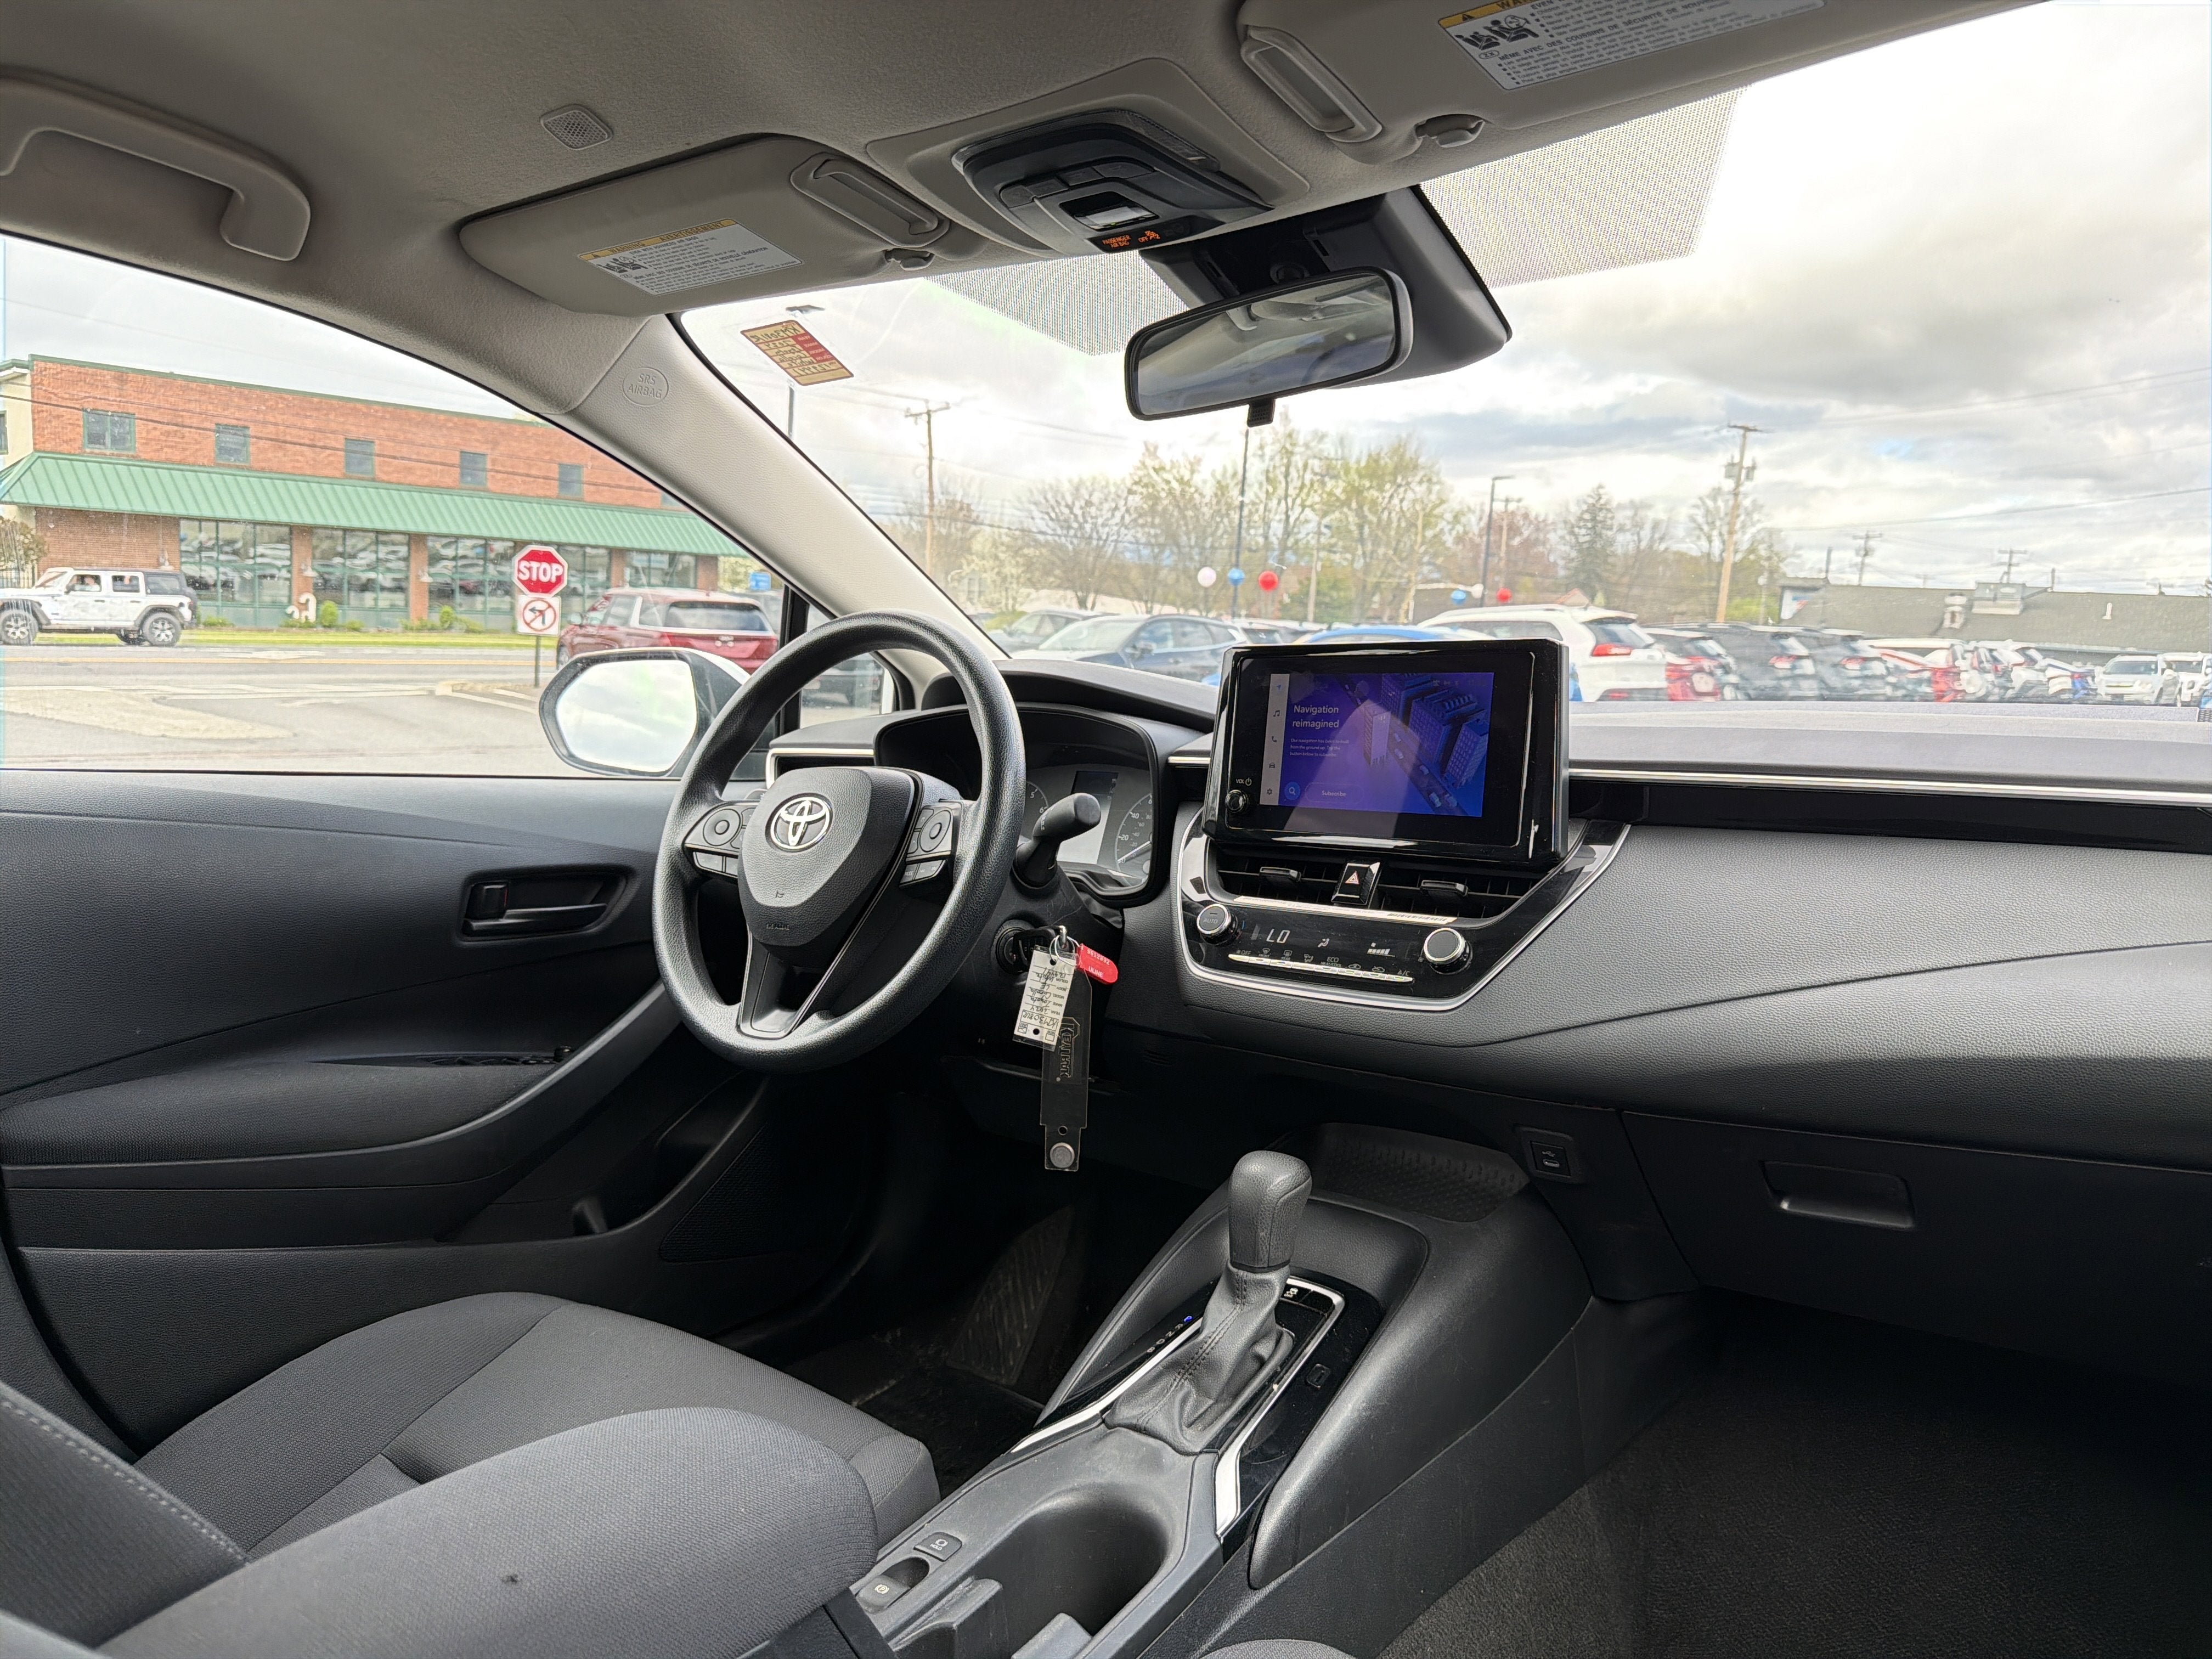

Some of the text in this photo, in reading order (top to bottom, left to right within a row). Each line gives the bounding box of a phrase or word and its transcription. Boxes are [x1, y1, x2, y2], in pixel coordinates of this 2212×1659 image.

[1521, 44, 1545, 54] AVEC
[1545, 39, 1564, 47] DES
[1563, 27, 1606, 42] COUSSINS
[610, 242, 645, 253] WARNING
[659, 222, 726, 241] AVERTISSEMENT
[1102, 235, 1131, 245] PASSENGER
[638, 374, 657, 385] SRS
[627, 384, 663, 399] AIRBAG
[518, 560, 563, 583] STOP
[1294, 705, 1339, 715] Navigation
[1293, 719, 1339, 730] reimagined
[1266, 929, 1290, 944] LO
